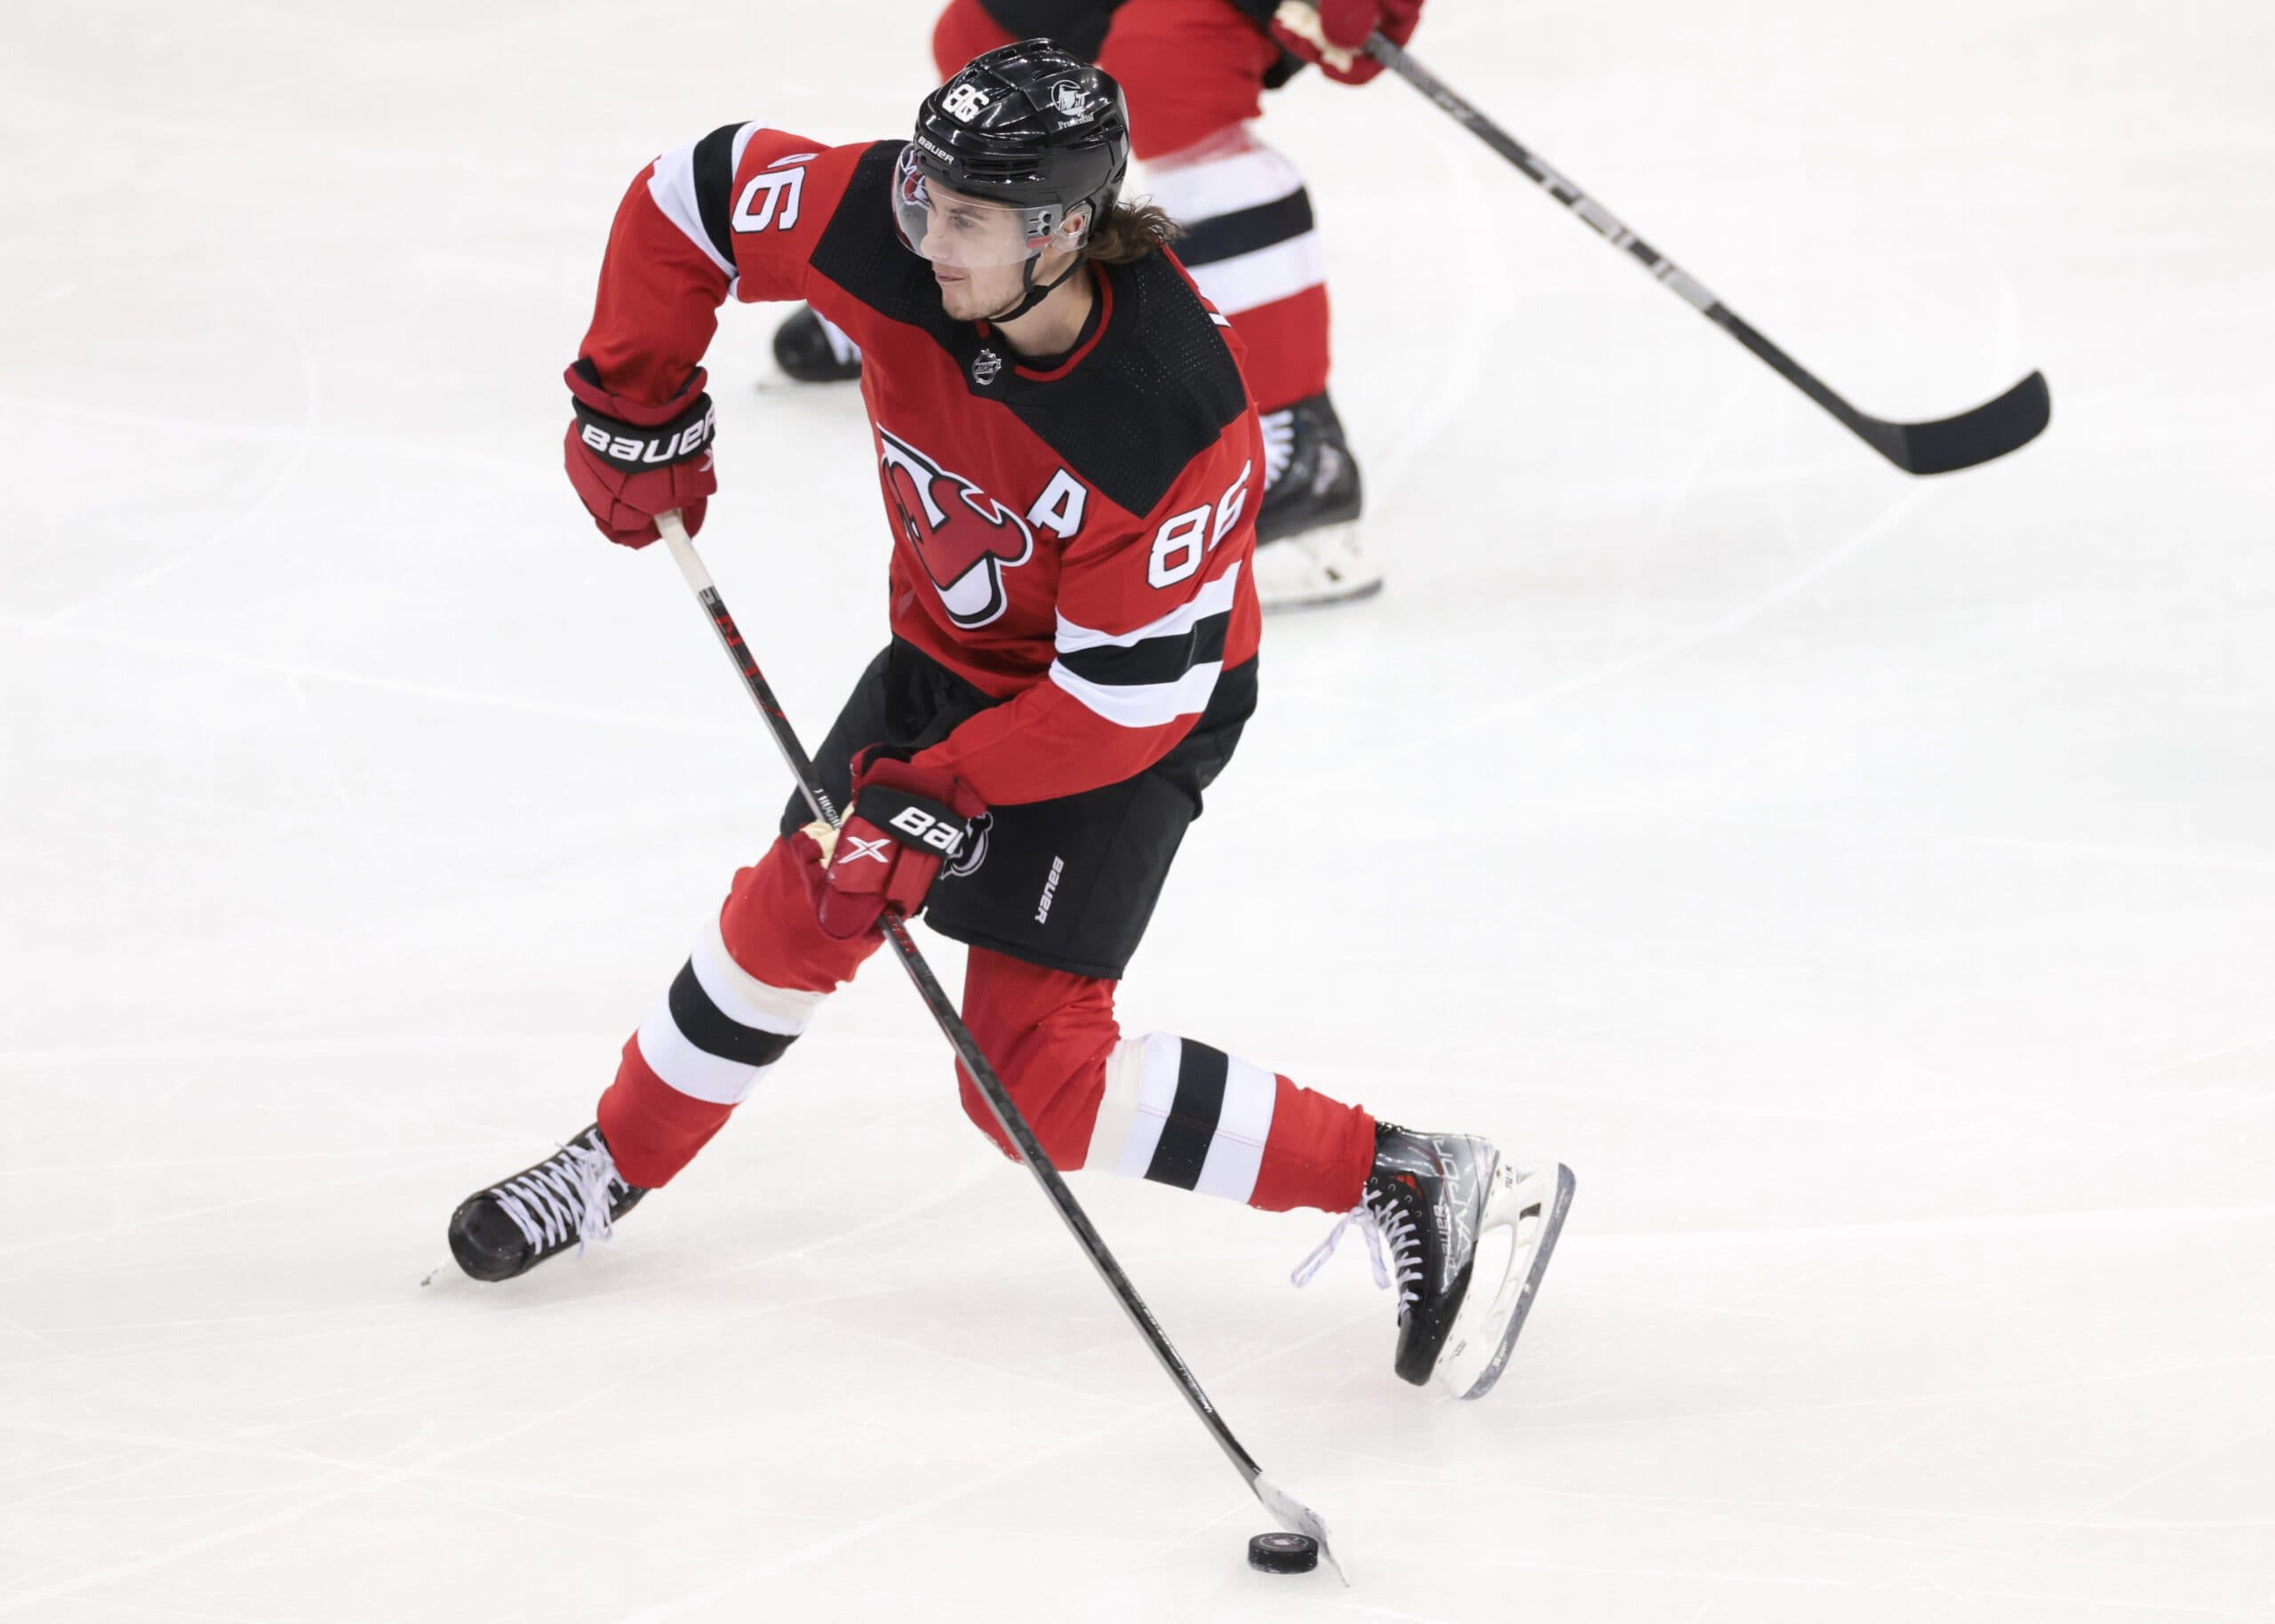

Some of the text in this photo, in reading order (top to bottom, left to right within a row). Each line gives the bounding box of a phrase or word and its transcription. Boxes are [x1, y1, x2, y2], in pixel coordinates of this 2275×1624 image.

[940, 83, 990, 123] 86
[1058, 112, 1095, 130] Prudential
[730, 153, 819, 234] 6
[1026, 468, 1088, 539] A
[1147, 458, 1251, 590] 86
